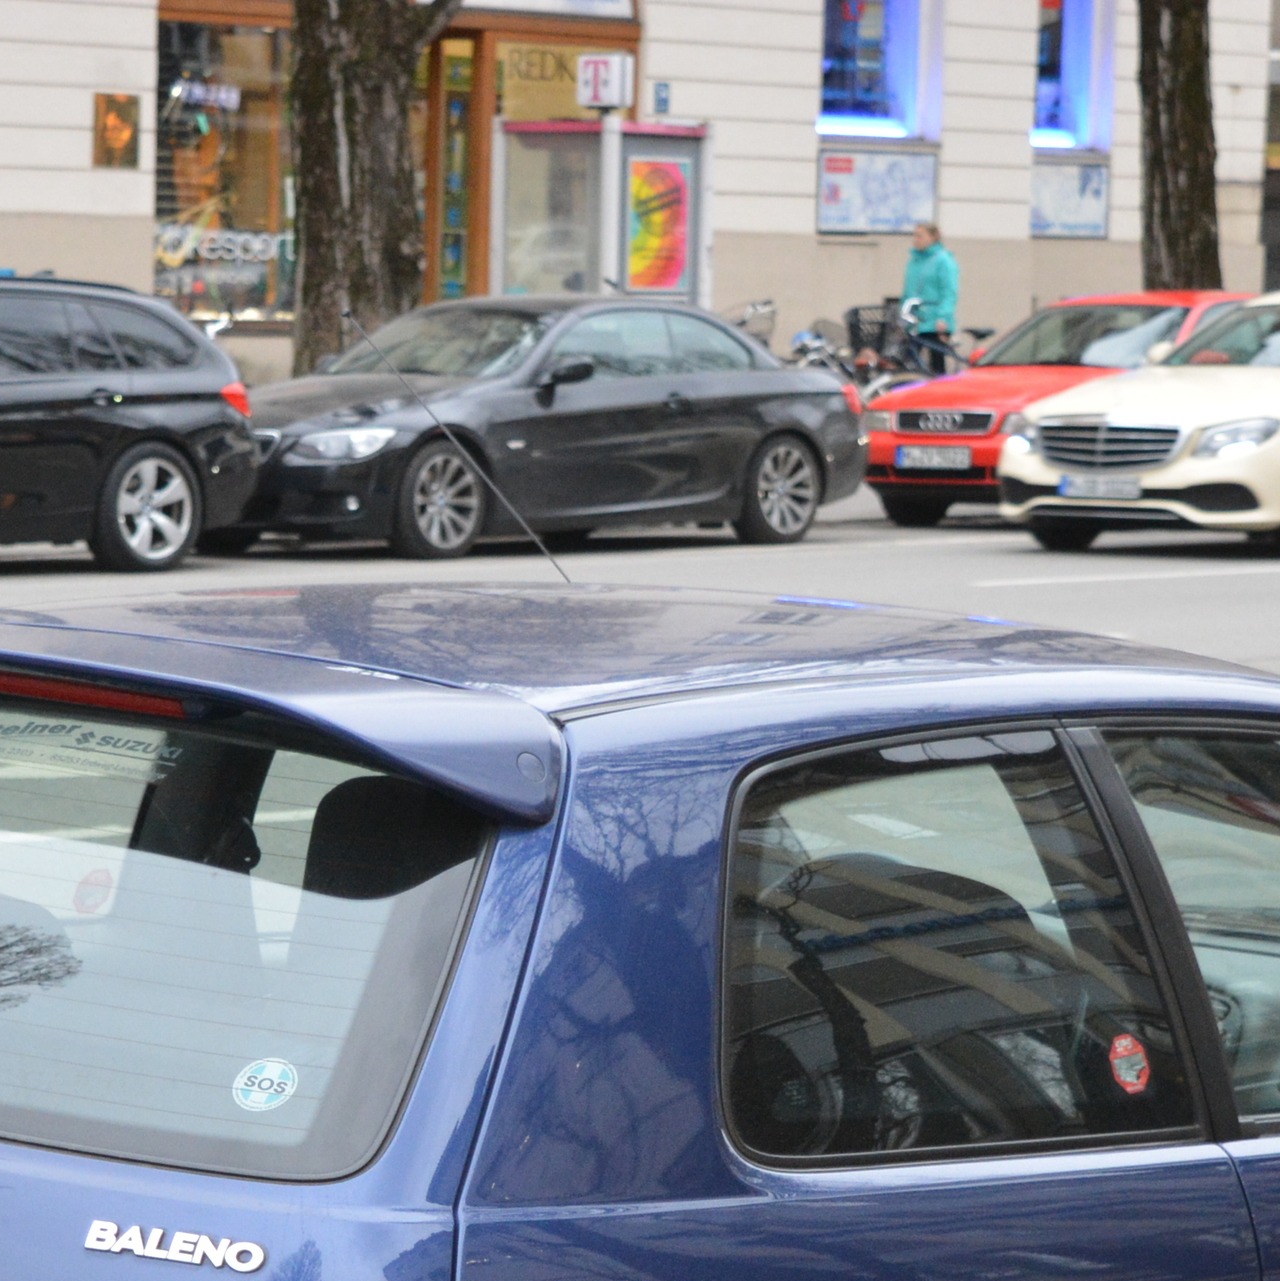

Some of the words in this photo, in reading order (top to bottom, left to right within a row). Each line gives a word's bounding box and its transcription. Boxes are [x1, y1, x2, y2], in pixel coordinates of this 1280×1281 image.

[509, 49, 577, 83] REDK
[96, 735, 183, 759] SUZUKI
[243, 1075, 288, 1095] SOS
[83, 1219, 266, 1273] BALENO
